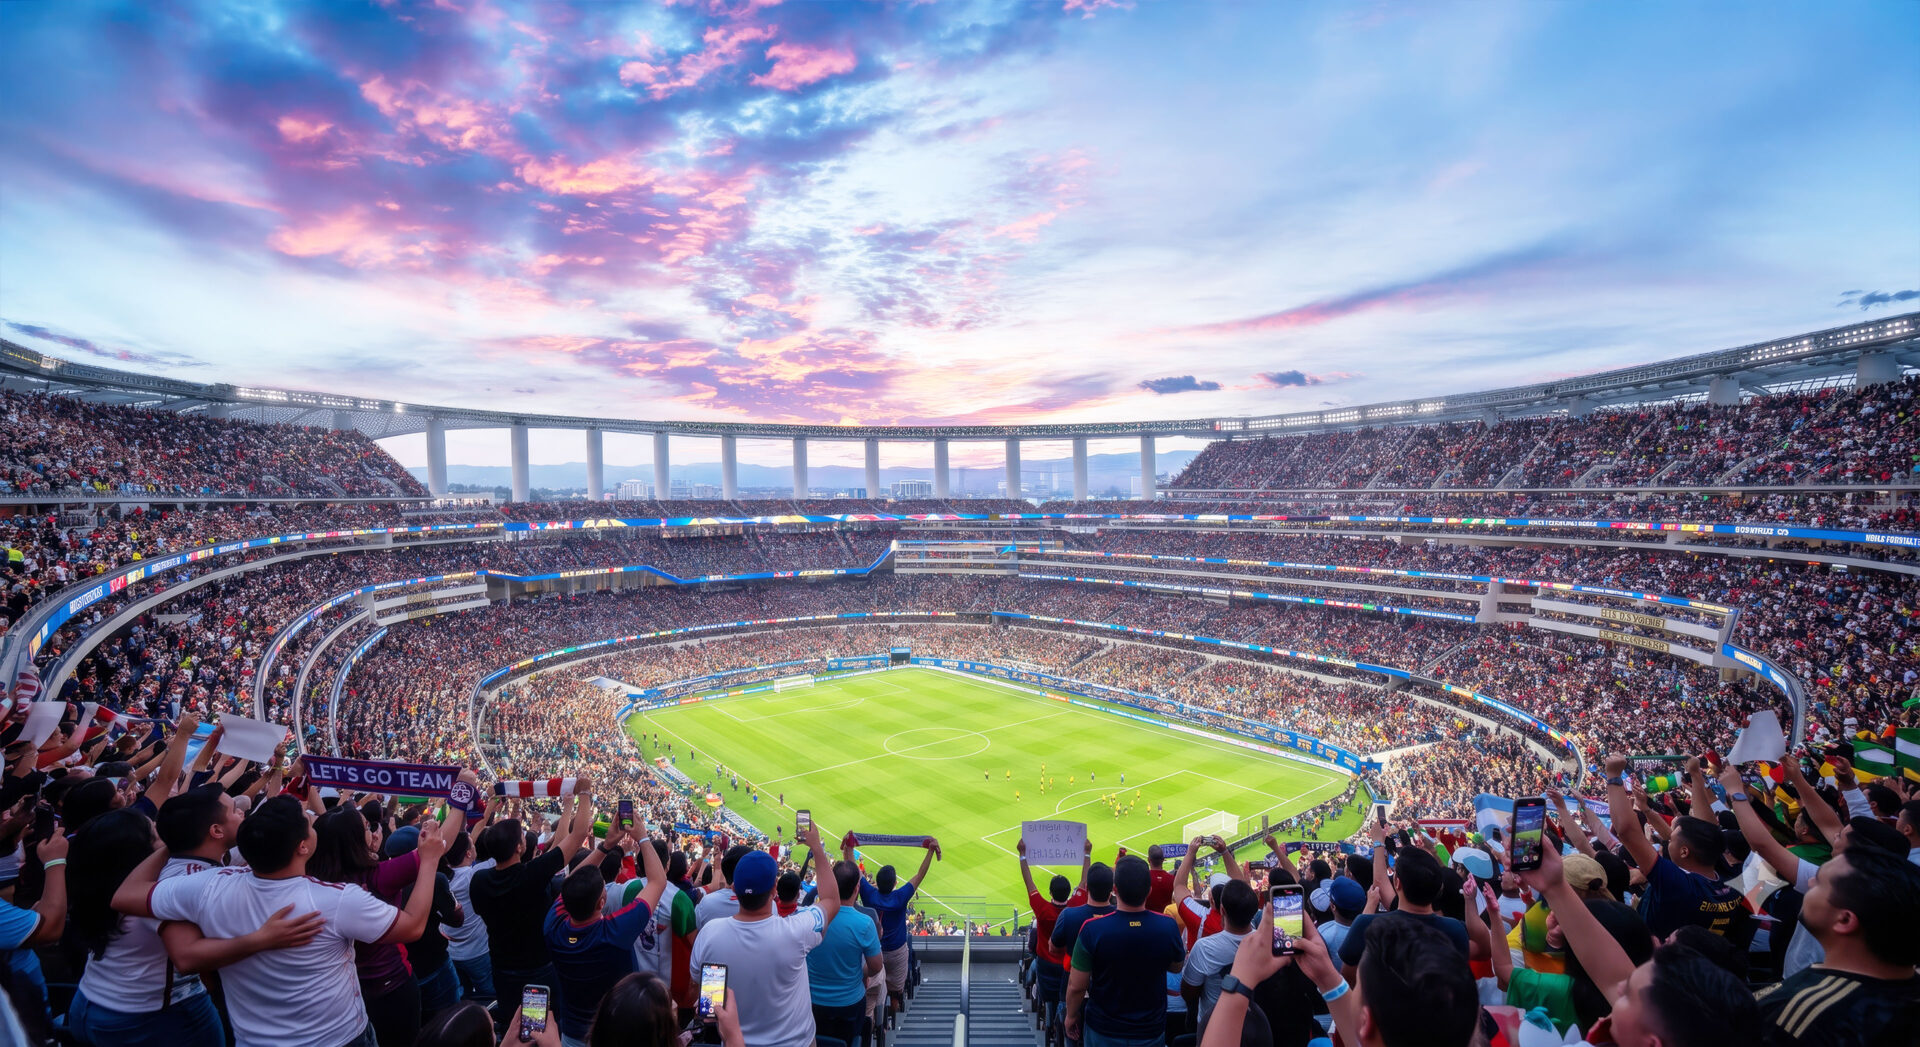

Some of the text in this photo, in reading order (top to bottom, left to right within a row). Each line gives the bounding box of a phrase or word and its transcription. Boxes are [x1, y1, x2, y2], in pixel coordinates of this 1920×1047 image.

[309, 762, 451, 790] LET'S GO TEAM
